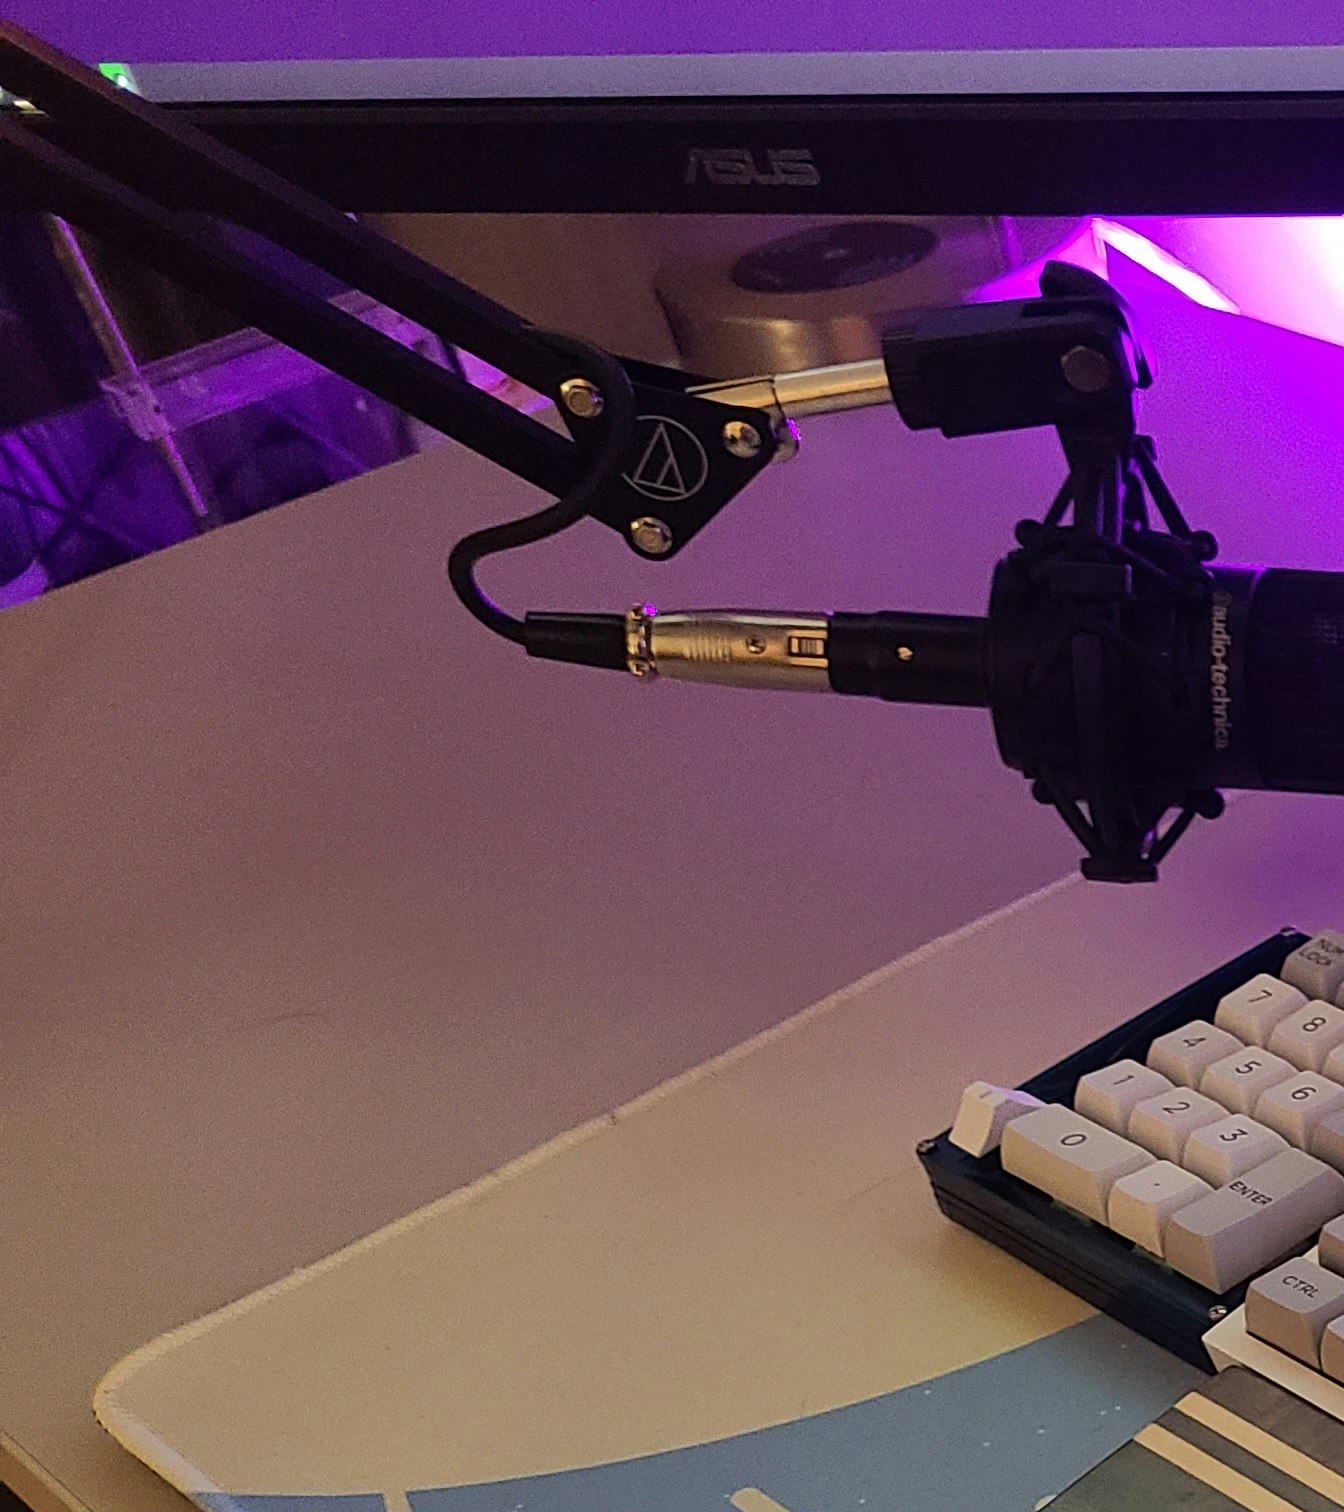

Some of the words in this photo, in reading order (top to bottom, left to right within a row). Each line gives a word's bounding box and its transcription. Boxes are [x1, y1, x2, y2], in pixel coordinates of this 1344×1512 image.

[685, 149, 821, 185] ASUS
[1210, 605, 1232, 749] audio-technica
[1247, 989, 1273, 1003] 7
[1302, 1016, 1327, 1033] 8
[1235, 1060, 1262, 1075] 5
[1113, 1074, 1135, 1086] 1
[1291, 1086, 1317, 1101] 6
[1162, 1101, 1191, 1115] 2
[1060, 1133, 1088, 1147] 0
[1219, 1128, 1248, 1142] 3
[1228, 1180, 1273, 1206] ENTER
[1282, 1275, 1319, 1299] CTRL
